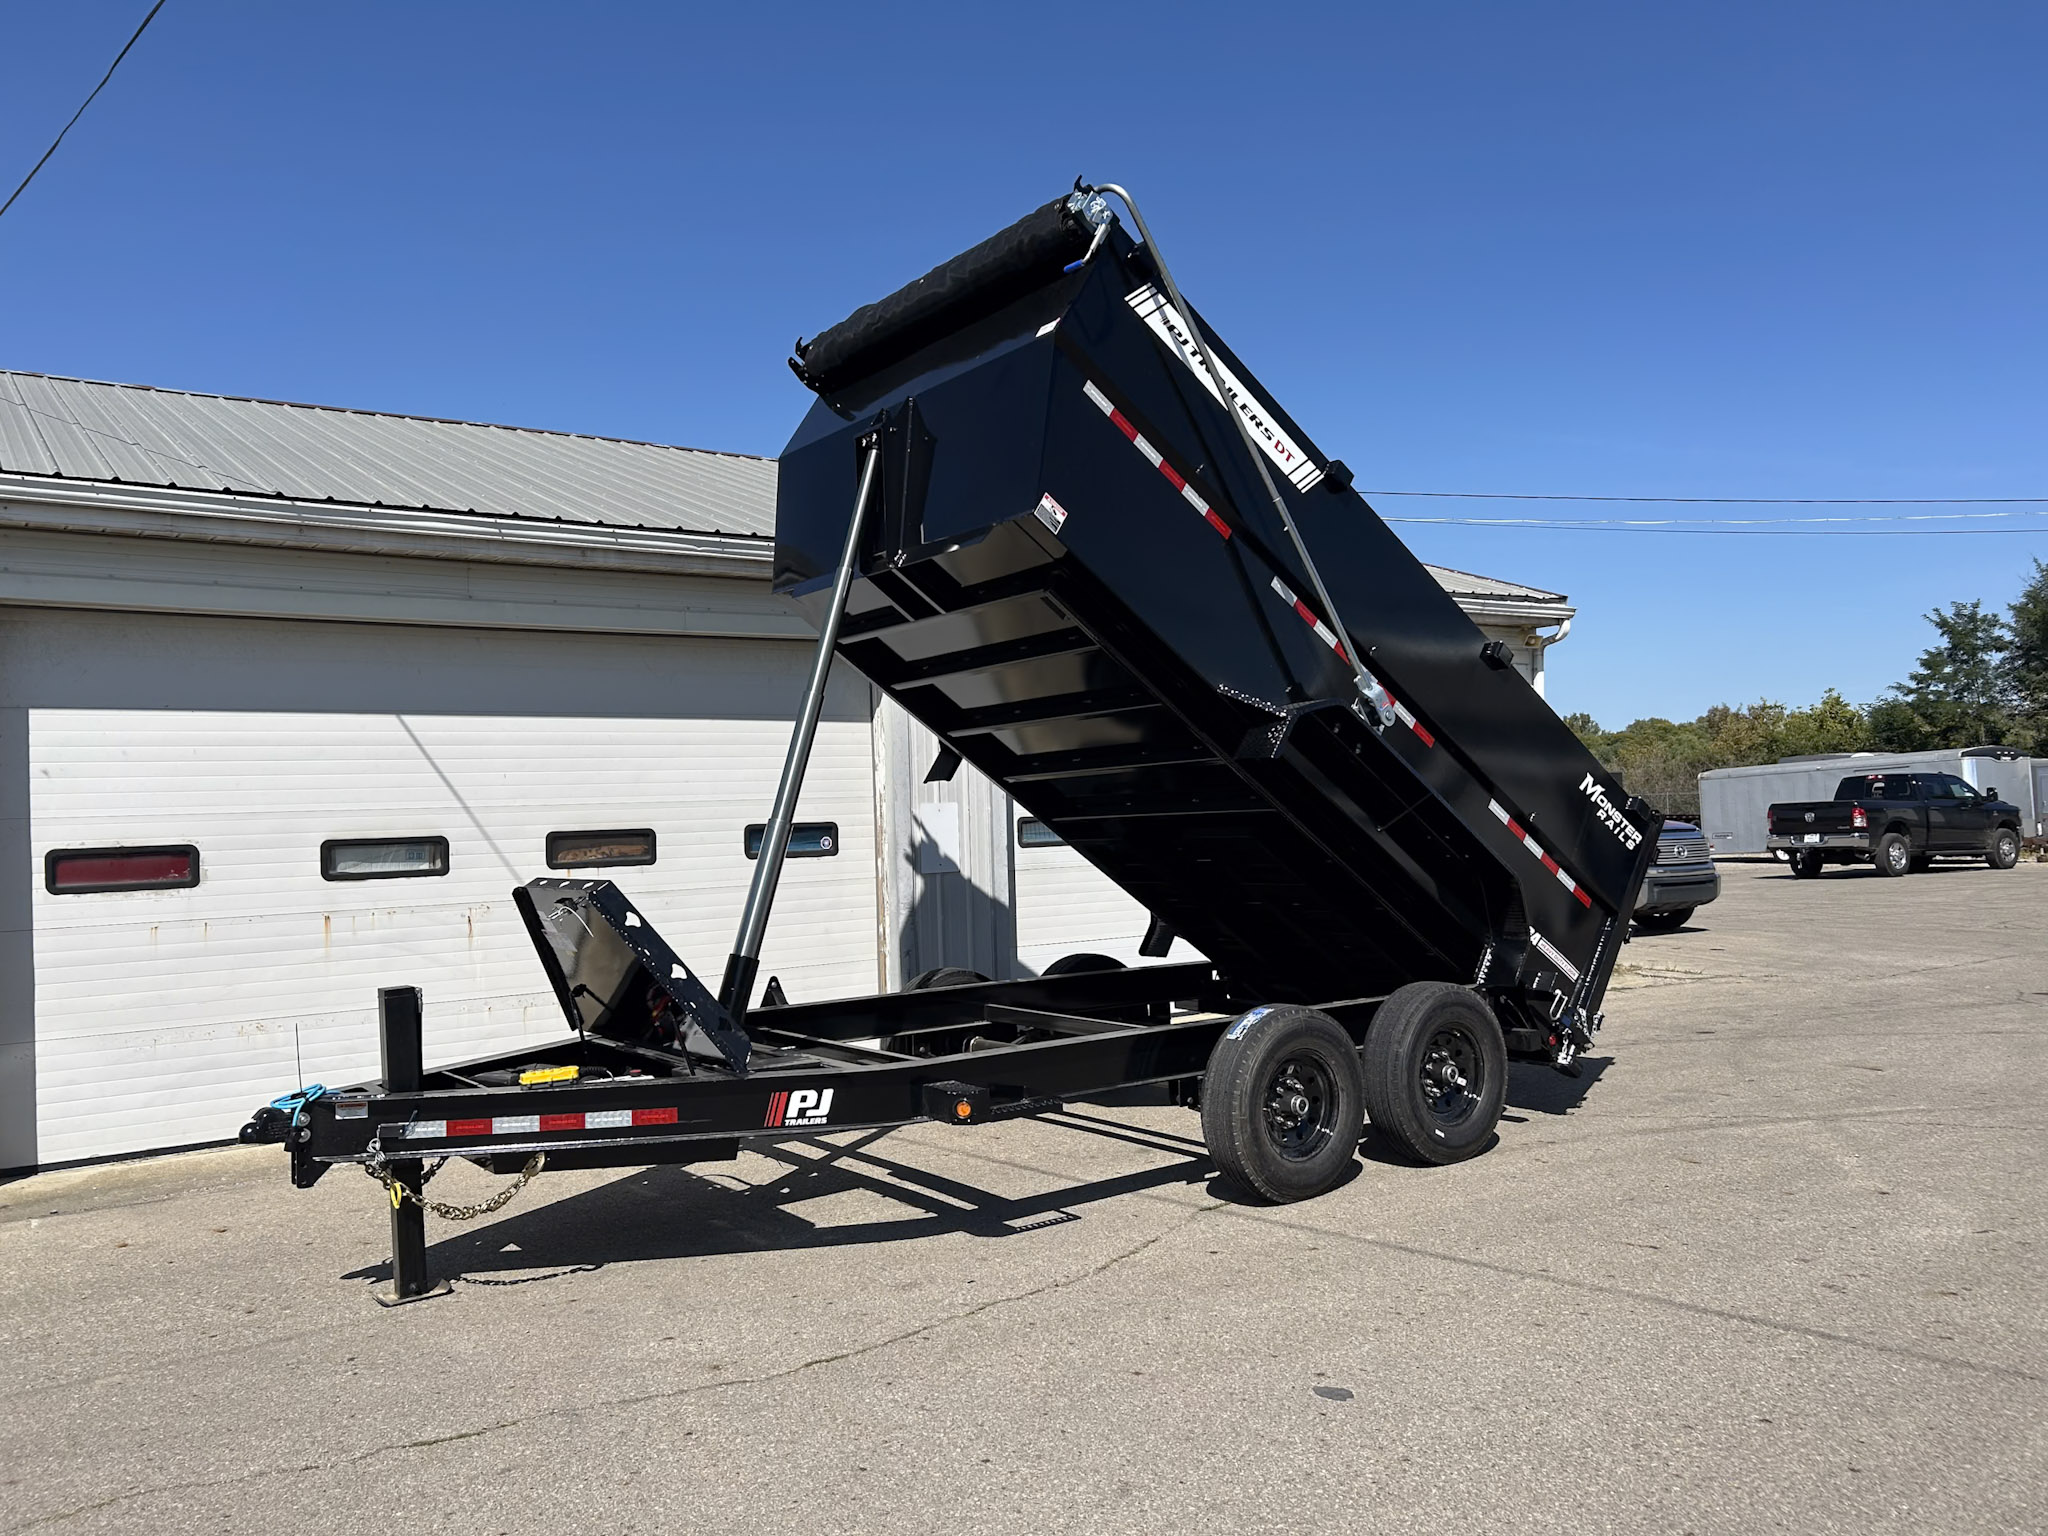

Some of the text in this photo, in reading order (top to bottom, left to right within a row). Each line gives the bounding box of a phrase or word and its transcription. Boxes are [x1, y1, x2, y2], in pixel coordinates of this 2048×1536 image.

[1190, 345, 1275, 441] TRILERS
[1274, 439, 1296, 463] DT
[1596, 808, 1636, 850] RAILS
[784, 1116, 828, 1126] TRAILERS
[786, 1088, 834, 1118] PJ
